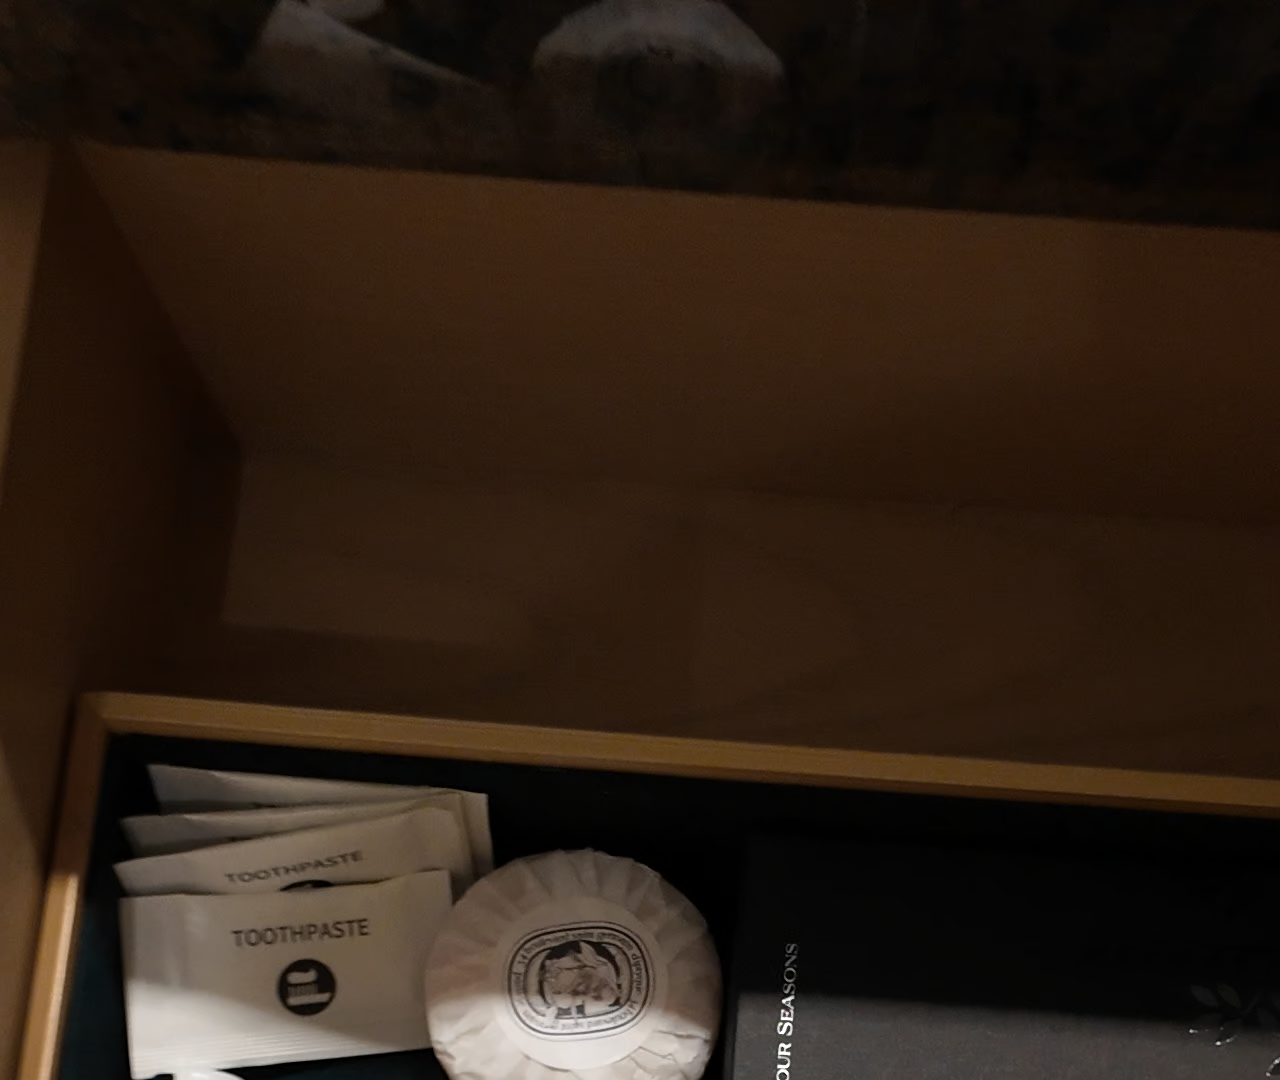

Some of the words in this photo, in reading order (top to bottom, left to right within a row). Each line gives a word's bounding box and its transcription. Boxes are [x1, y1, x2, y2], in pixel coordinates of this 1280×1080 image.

[224, 850, 364, 883] TOOTHPASTE
[231, 918, 370, 947] TOOTHPASTE
[777, 943, 798, 1036] SEASONS
